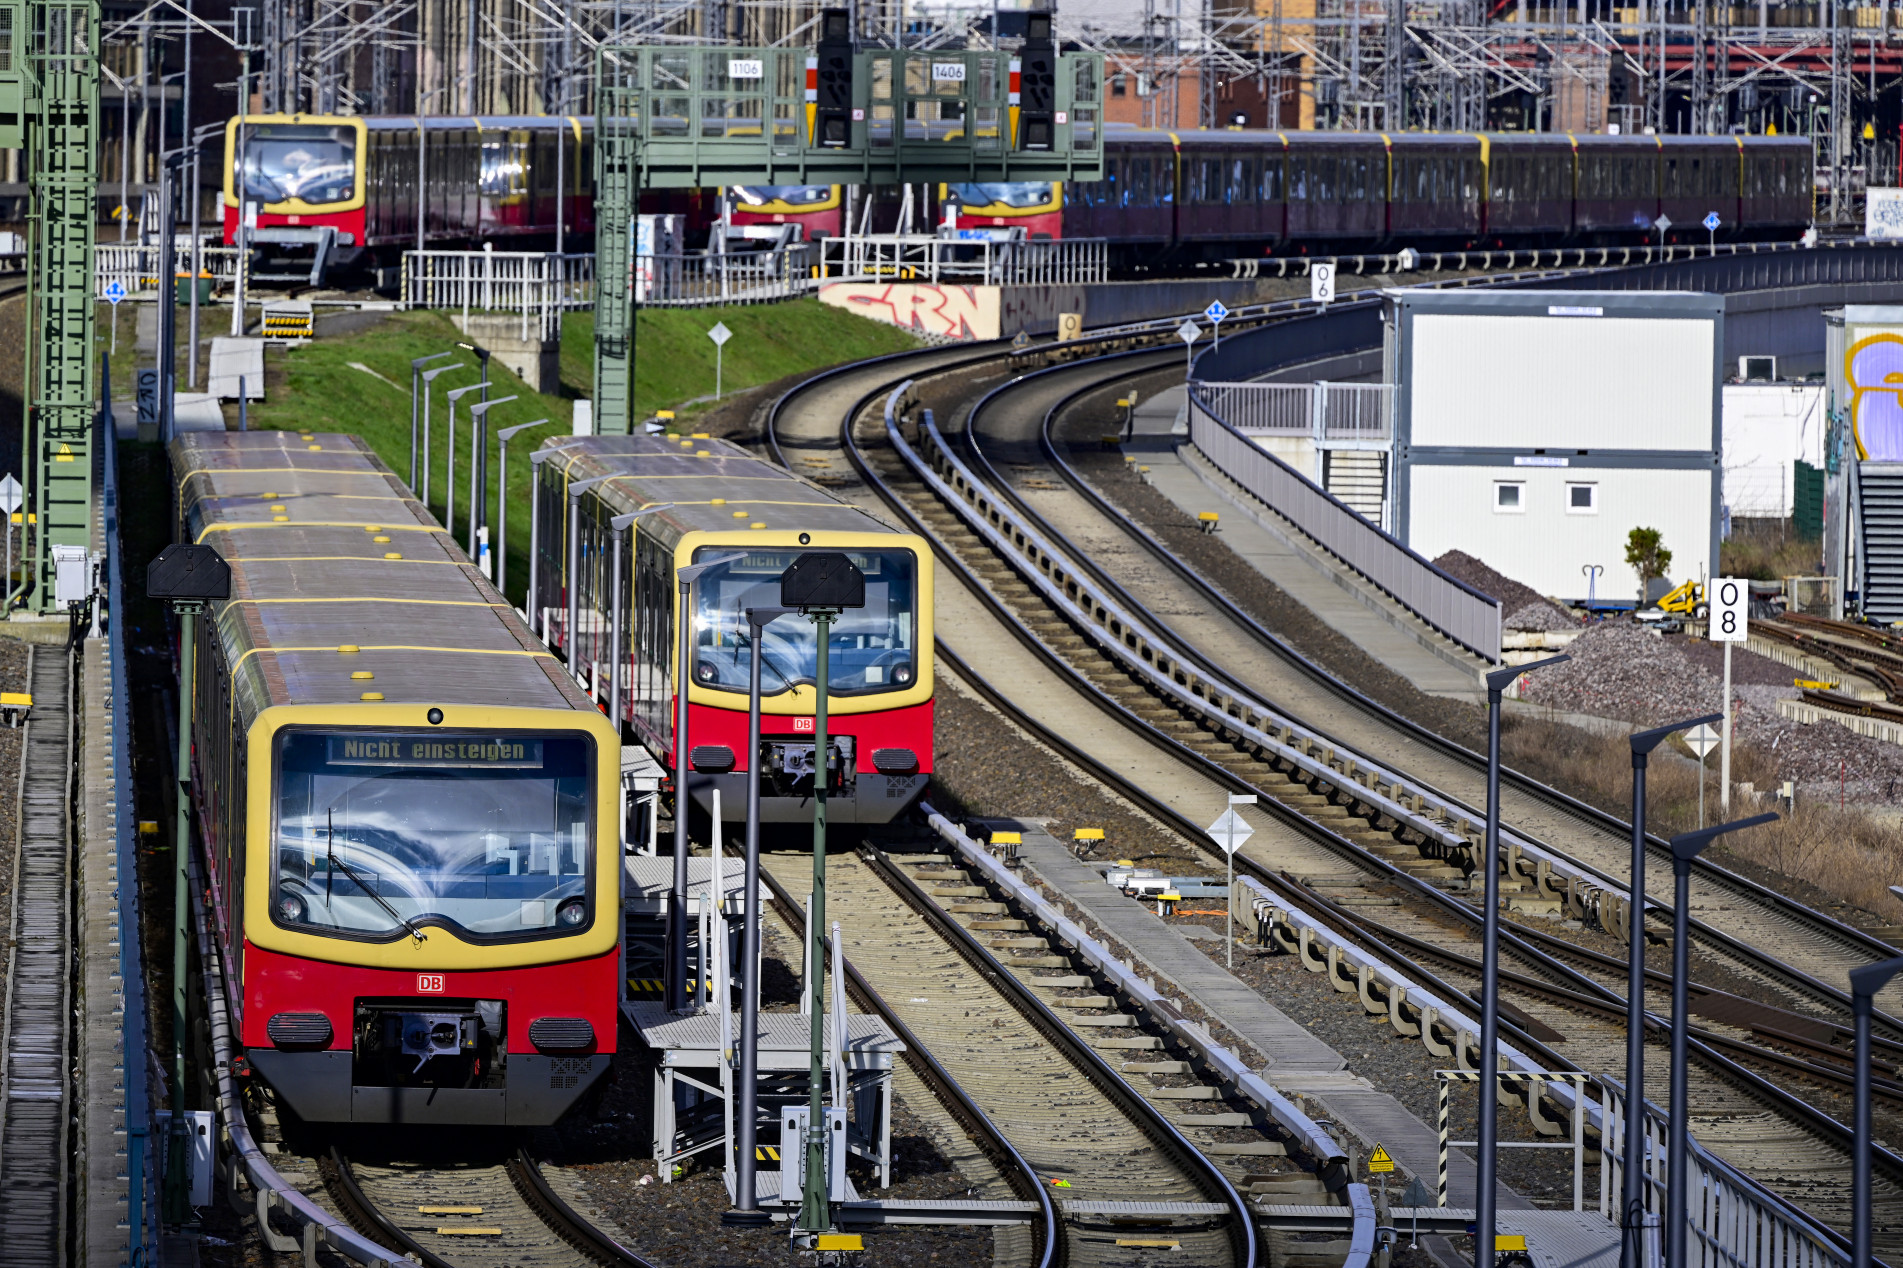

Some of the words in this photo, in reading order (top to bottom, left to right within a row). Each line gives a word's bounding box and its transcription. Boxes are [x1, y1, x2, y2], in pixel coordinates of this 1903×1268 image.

[734, 63, 759, 74] 1106
[935, 66, 962, 78] 1406
[795, 718, 812, 729] DB
[345, 740, 400, 758] Nicht
[412, 743, 524, 760] einsteigen
[419, 975, 443, 991] DB
